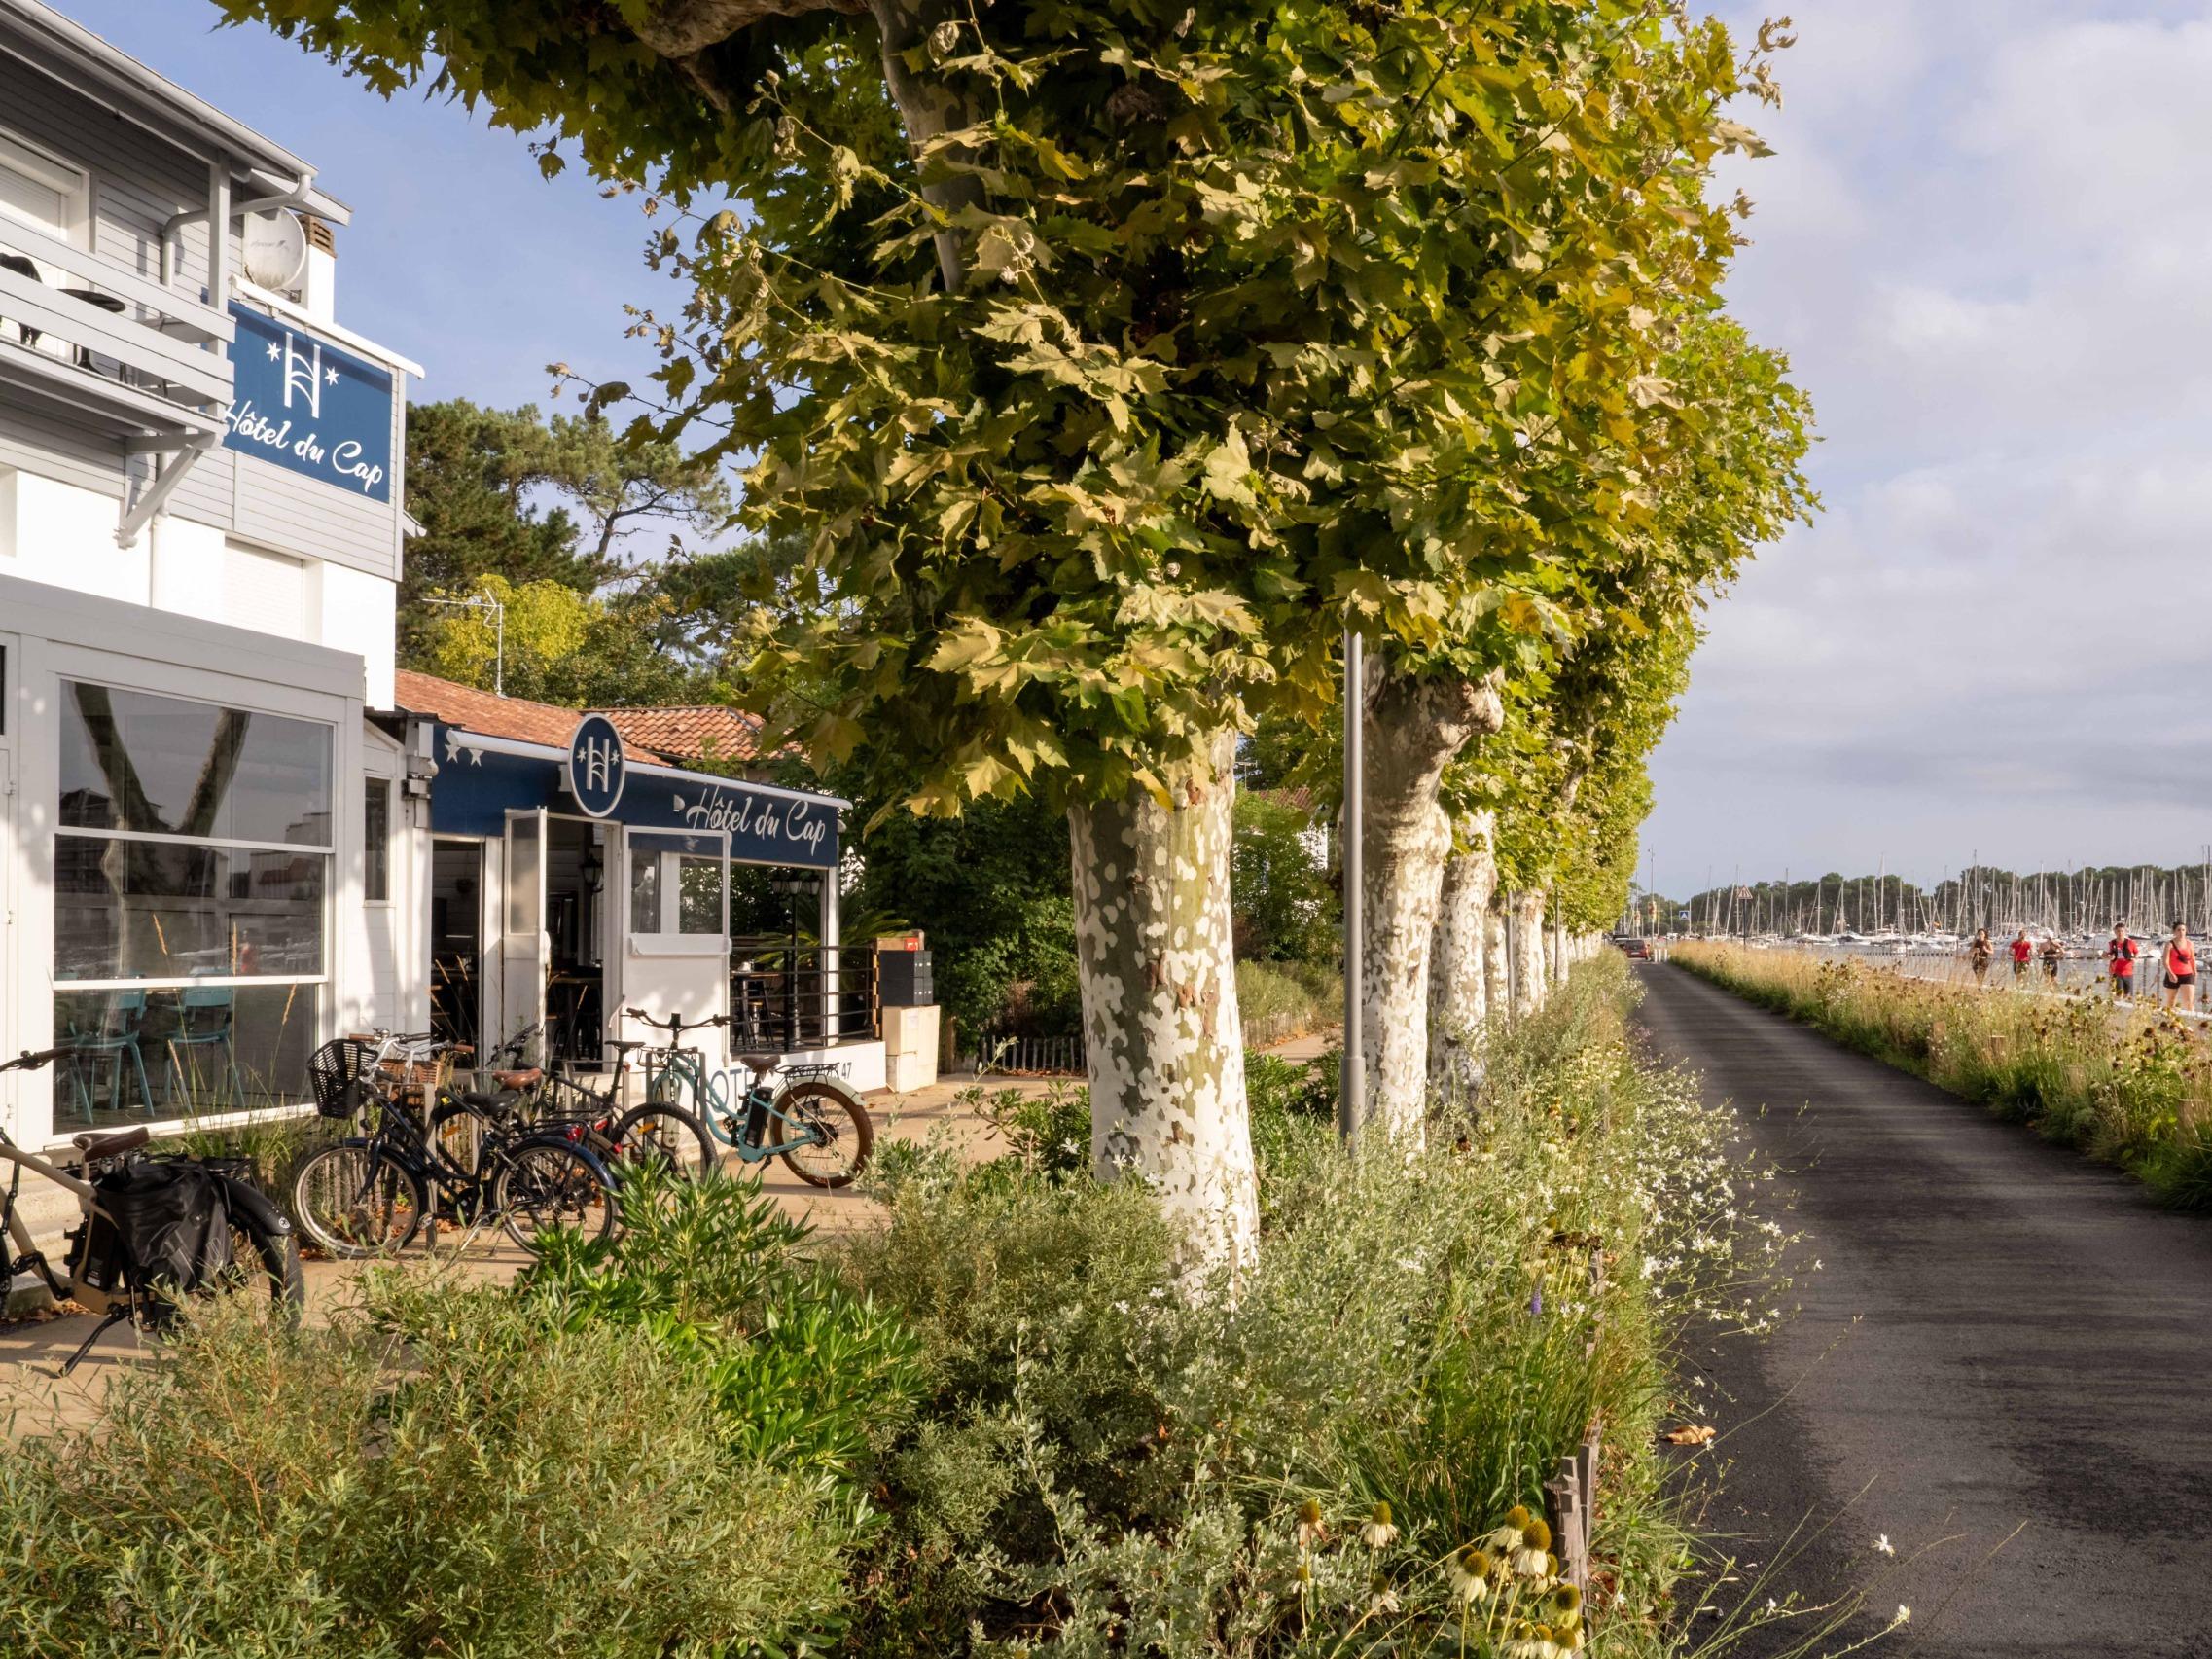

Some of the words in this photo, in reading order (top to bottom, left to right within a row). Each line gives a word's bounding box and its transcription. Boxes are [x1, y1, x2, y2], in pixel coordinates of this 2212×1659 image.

[224, 399, 291, 449] Hôtel
[294, 432, 325, 464] du
[333, 441, 383, 492] Cap
[686, 786, 752, 833] Hôtel
[755, 803, 779, 840] du
[786, 800, 826, 856] Cap
